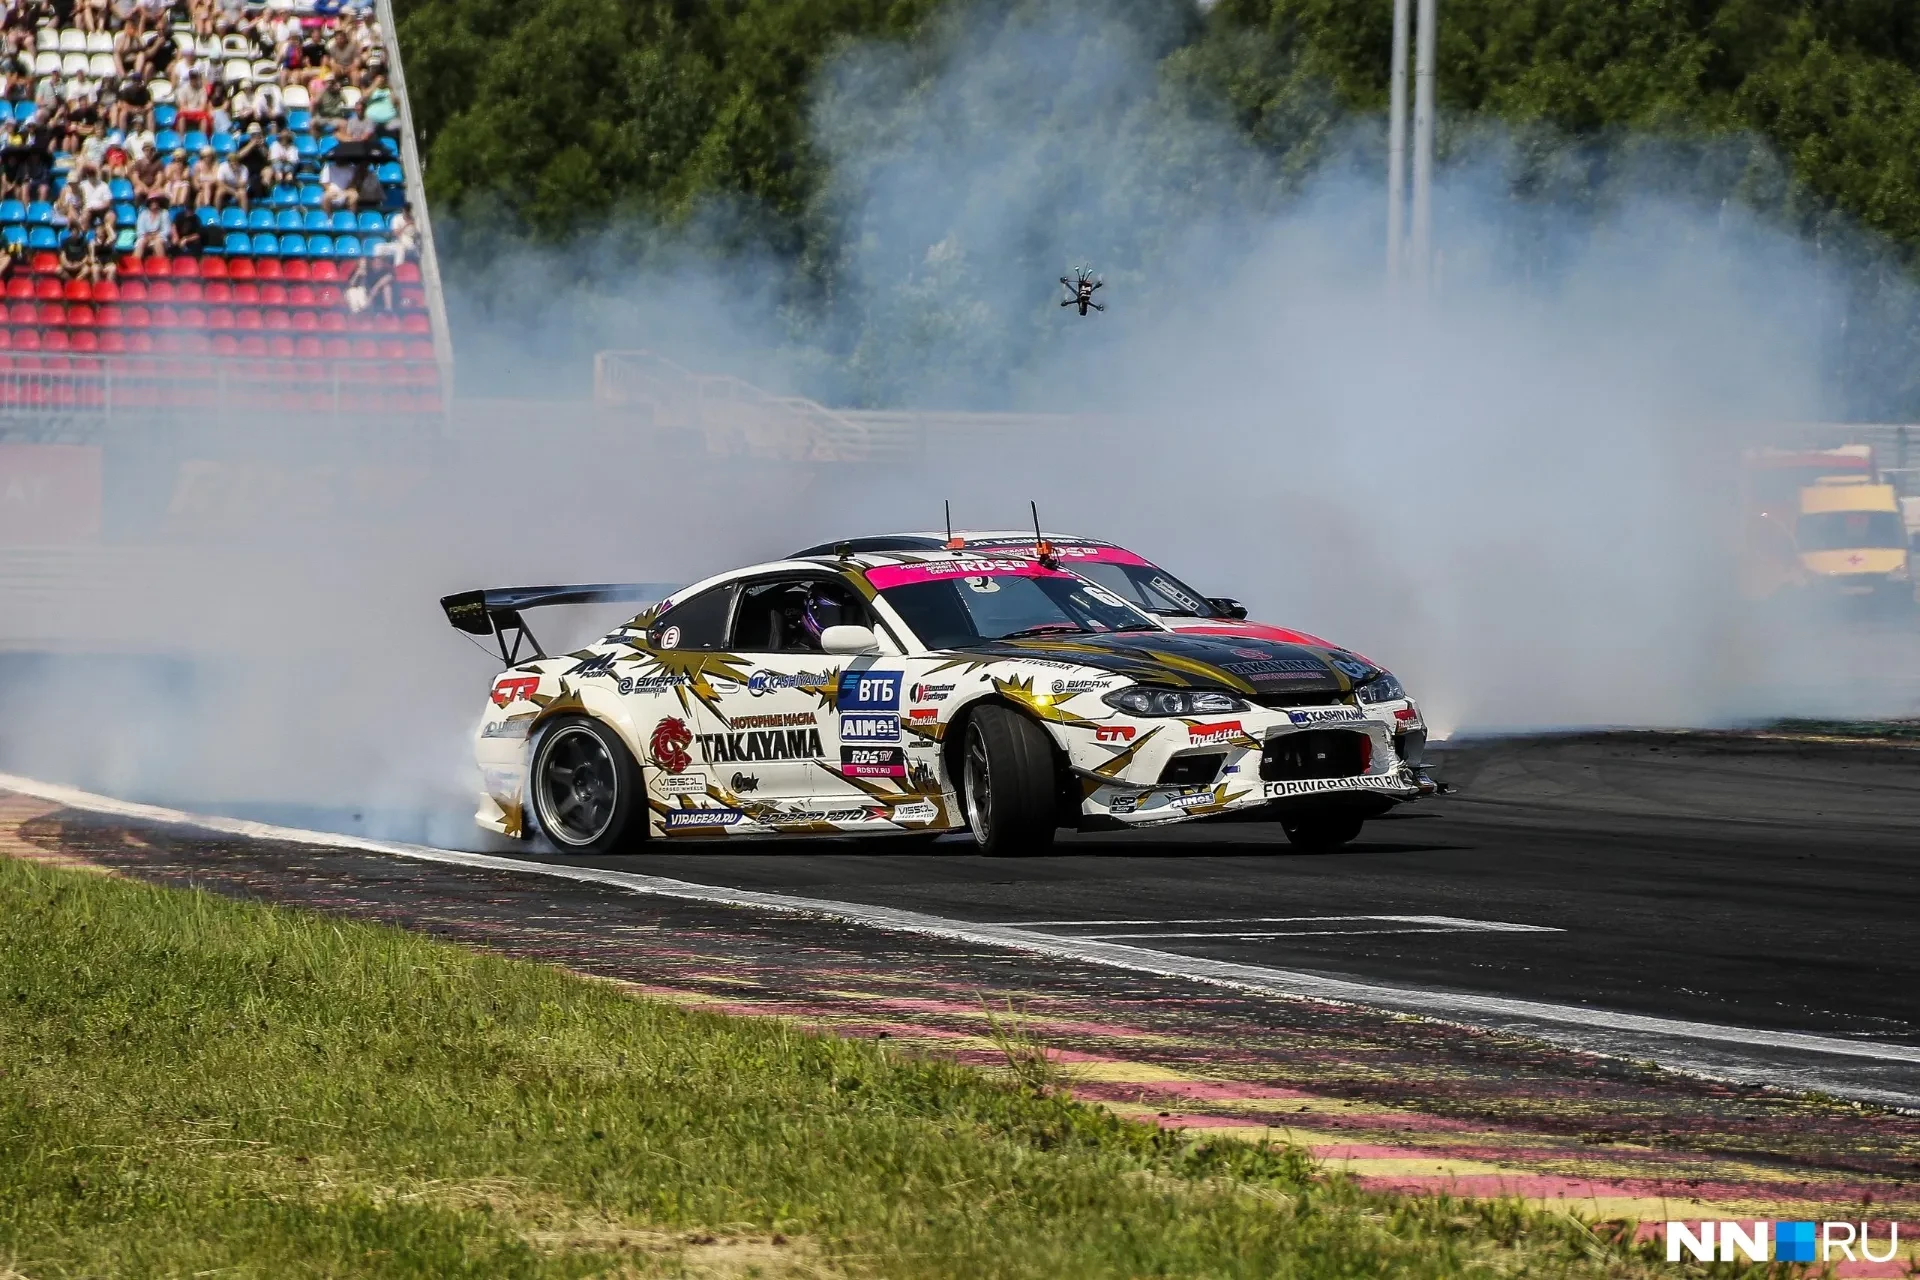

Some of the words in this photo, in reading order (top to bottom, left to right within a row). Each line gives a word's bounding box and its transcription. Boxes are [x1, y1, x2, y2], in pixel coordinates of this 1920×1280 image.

[955, 559, 1016, 572] RDS
[666, 632, 675, 645] E
[635, 676, 689, 688] ВИРАЖ
[923, 683, 956, 691] Standard
[1066, 680, 1113, 689] ВИРАЖ
[858, 679, 895, 702] ВТБ
[922, 691, 949, 702] Springs
[730, 714, 783, 729] МОТОРНЫЕ
[783, 711, 817, 725] МАСЛА
[908, 715, 938, 727] makita
[841, 719, 899, 737] AIMOL
[1189, 728, 1244, 746] makita
[695, 728, 826, 764] TAKAYAMA
[851, 750, 880, 764] RDS
[856, 767, 891, 775] RDSTV.RU
[658, 777, 703, 787] VISSOL
[1263, 774, 1401, 798] FORWARDAUTO.RU
[1112, 796, 1136, 806] ASP
[1171, 794, 1215, 809] AIMOL
[897, 804, 934, 815] VISSOL
[671, 813, 738, 826] VIRAGE24.RU
